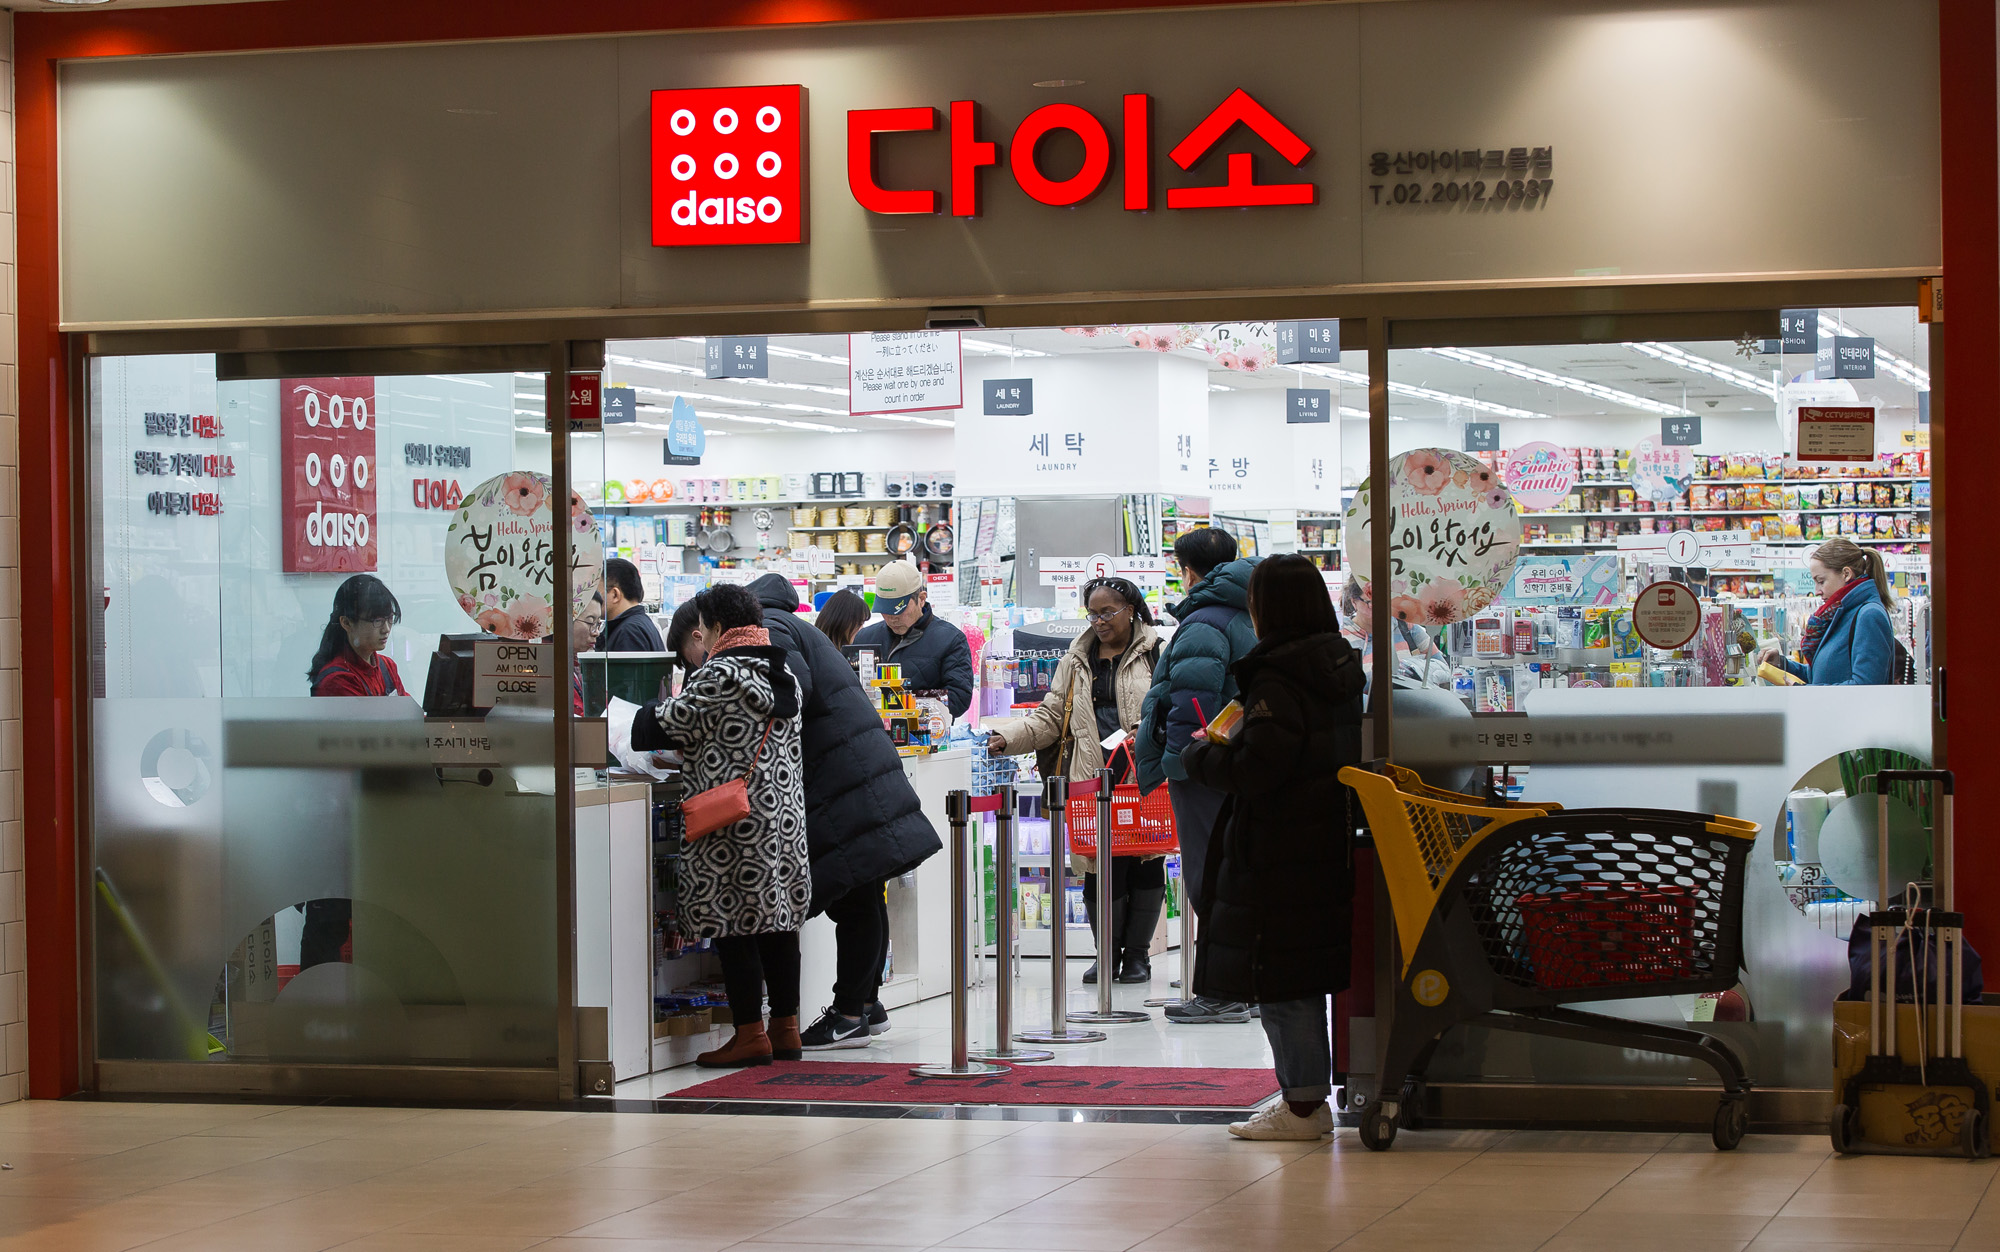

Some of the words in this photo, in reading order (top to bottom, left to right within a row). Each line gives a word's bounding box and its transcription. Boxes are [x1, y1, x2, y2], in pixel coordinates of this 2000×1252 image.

[847, 87, 1315, 218] 다이소
[670, 190, 782, 226] daiso
[1309, 327, 1331, 343] 미용
[734, 344, 757, 360] 욕실
[875, 343, 939, 358] 一列に立ってください
[1309, 346, 1331, 354] BEAUTY
[1840, 347, 1870, 361] 인테리어
[854, 368, 875, 381] 계산은
[876, 366, 904, 380] 순서대로
[905, 361, 955, 377] 해드리겠습니다.
[862, 381, 883, 392] Please
[884, 380, 896, 390] wait
[897, 380, 909, 389] one
[910, 379, 918, 389] by
[919, 378, 932, 387] one
[932, 376, 945, 386] and
[569, 389, 592, 406] 스원
[884, 395, 901, 404] count
[902, 393, 908, 402] in
[909, 392, 926, 402] order
[995, 387, 1021, 400] 세탁
[1297, 397, 1319, 409] 리빙
[179, 414, 191, 437] 건
[1670, 423, 1692, 434] 완구
[1028, 432, 1085, 457] 세탁
[404, 442, 433, 466] 언제나
[1643, 449, 1680, 463] 보들보들
[1036, 463, 1078, 472] LAUNDRY
[1208, 457, 1250, 479] 주방
[1511, 459, 1571, 476] Cookie
[1643, 463, 1680, 476] 인형모음
[1209, 483, 1242, 491] KITCHEN
[1511, 474, 1568, 492] candy
[412, 477, 464, 511] 다이소
[1401, 500, 1435, 518] Hello,
[1436, 496, 1478, 517] Spring
[306, 501, 370, 548] daiso
[497, 520, 528, 537] Hello,
[529, 518, 552, 537] Spri
[1428, 517, 1512, 567] 왔어요
[1711, 533, 1739, 542] 파우치
[1680, 540, 1686, 557] 1
[1704, 549, 1732, 557] 가방
[1096, 562, 1105, 578] 5
[1128, 560, 1155, 568] 화장품
[744, 571, 756, 581] 23
[1051, 574, 1076, 583] 헤어용품
[1531, 568, 1546, 578] 우리
[1523, 583, 1547, 594] 신학기
[1550, 583, 1573, 593] 준비물
[1046, 623, 1087, 634] Cosme
[497, 646, 537, 660] OPEN
[495, 664, 509, 673] AM
[513, 664, 538, 674] 10:00
[497, 680, 537, 693] CLOSE
[433, 737, 466, 749] 주시기
[1493, 733, 1518, 746] 열린
[1522, 733, 1533, 746] 후
[247, 933, 256, 985] 다이소
[262, 929, 272, 982] 다이소
[904, 1076, 1228, 1090] 다이소
